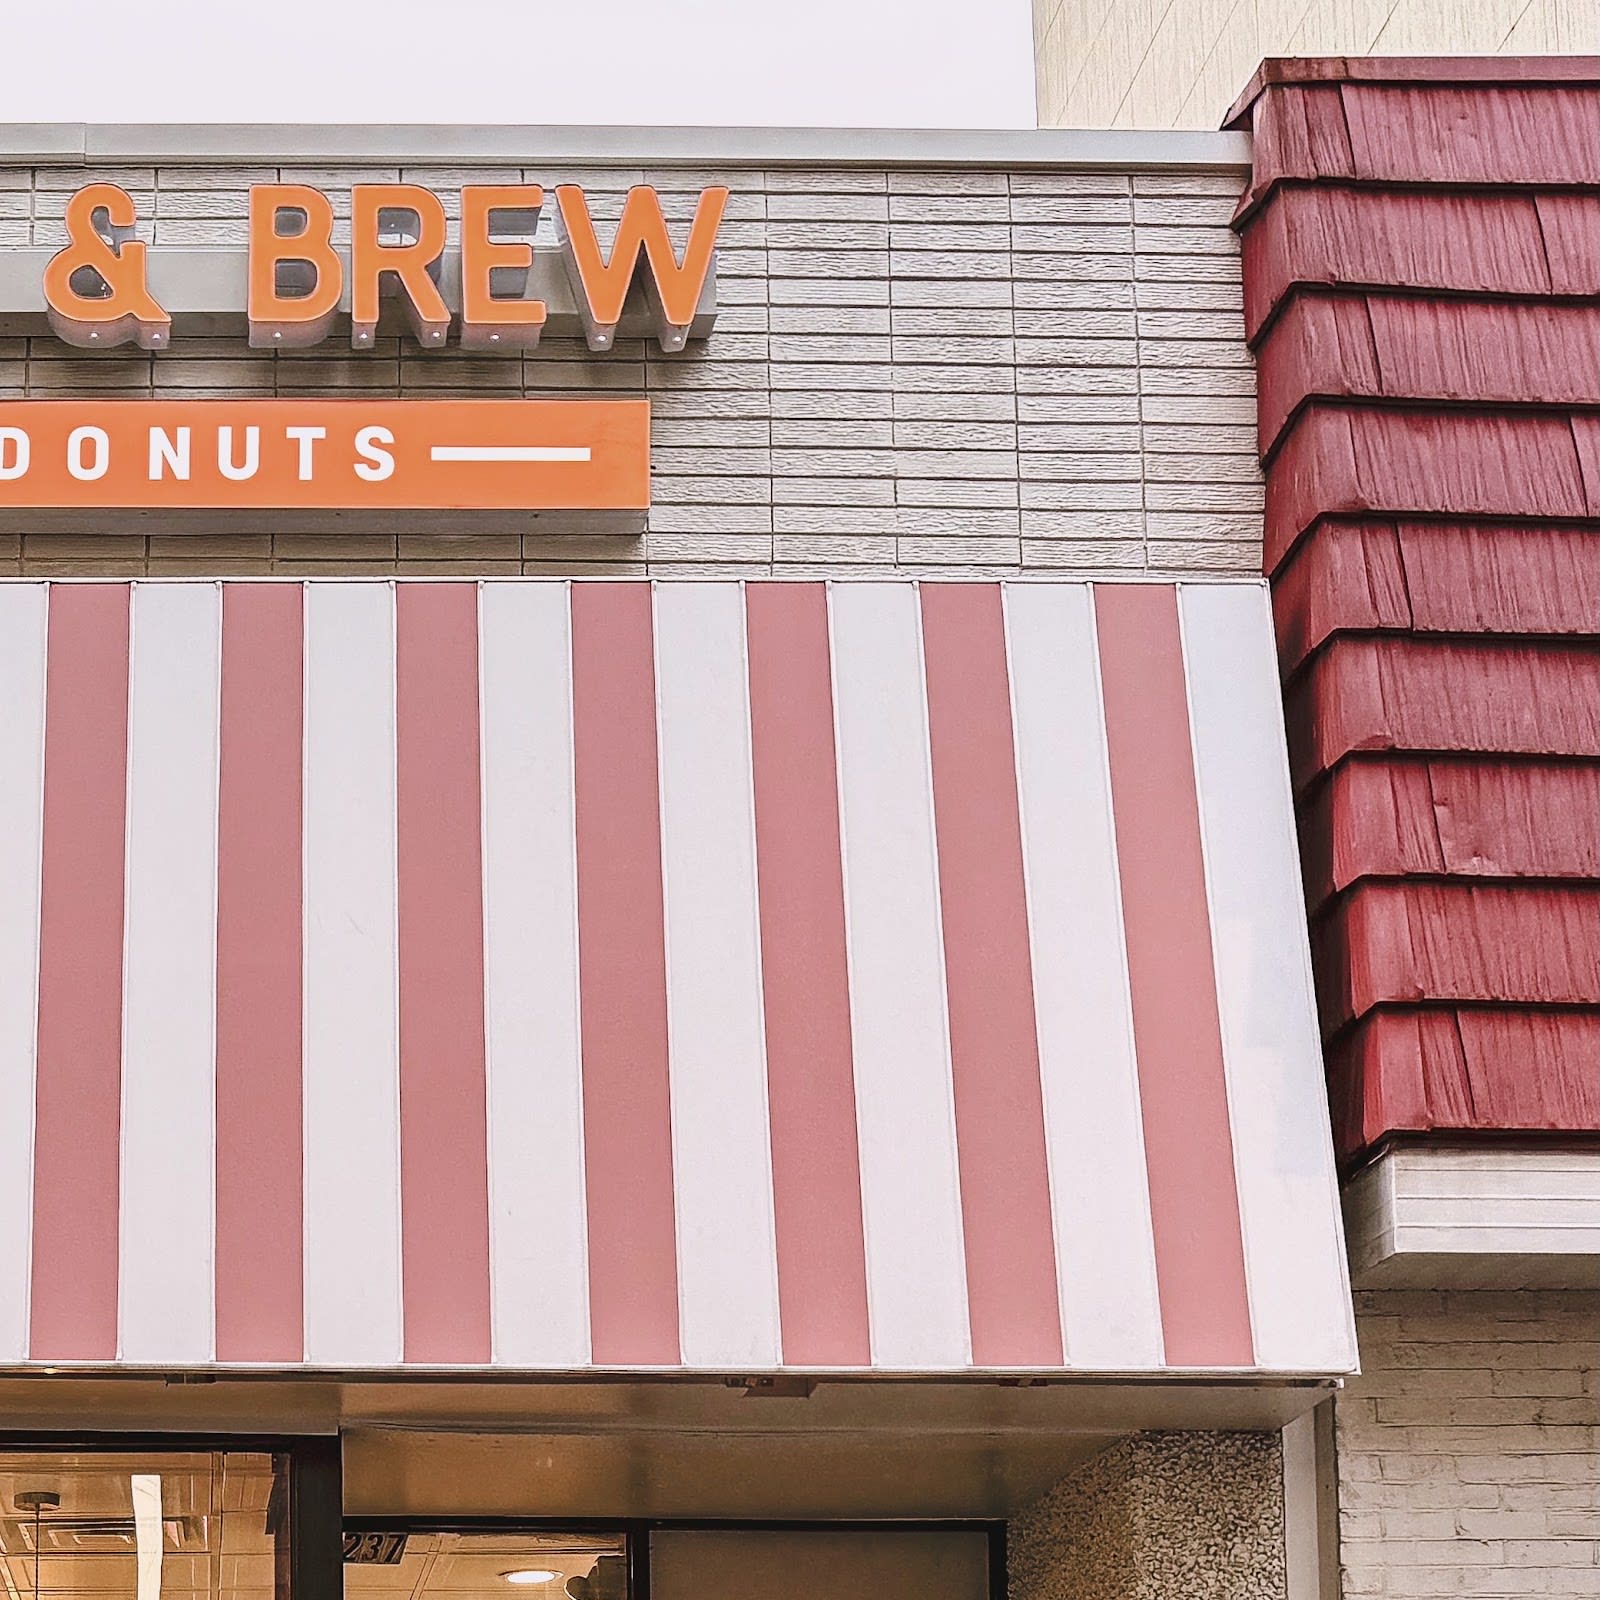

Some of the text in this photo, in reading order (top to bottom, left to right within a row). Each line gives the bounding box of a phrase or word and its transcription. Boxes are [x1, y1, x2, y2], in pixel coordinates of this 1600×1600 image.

[43, 183, 172, 325] &
[247, 183, 730, 327] BREW
[342, 1532, 407, 1563] 237
